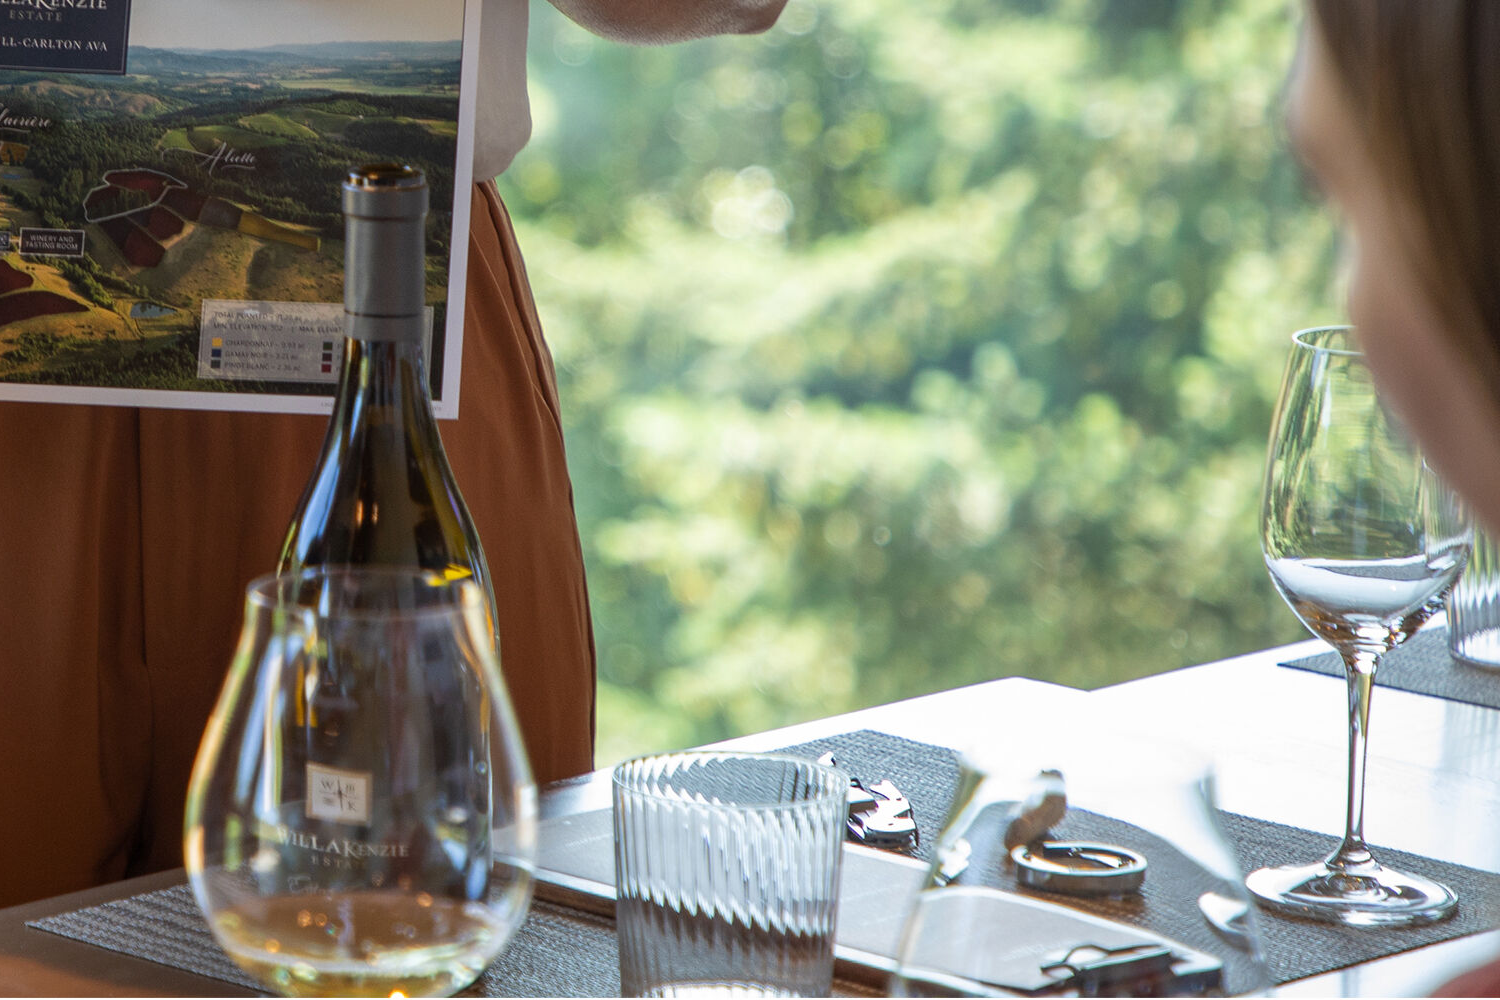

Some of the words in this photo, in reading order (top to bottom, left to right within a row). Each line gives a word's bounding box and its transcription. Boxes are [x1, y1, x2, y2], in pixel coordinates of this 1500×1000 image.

[9, 9, 63, 22] ESTATE
[86, 40, 108, 51] AVA
[58, 235, 74, 243] AND
[25, 241, 55, 249] TASTING
[56, 242, 78, 250] ROOM
